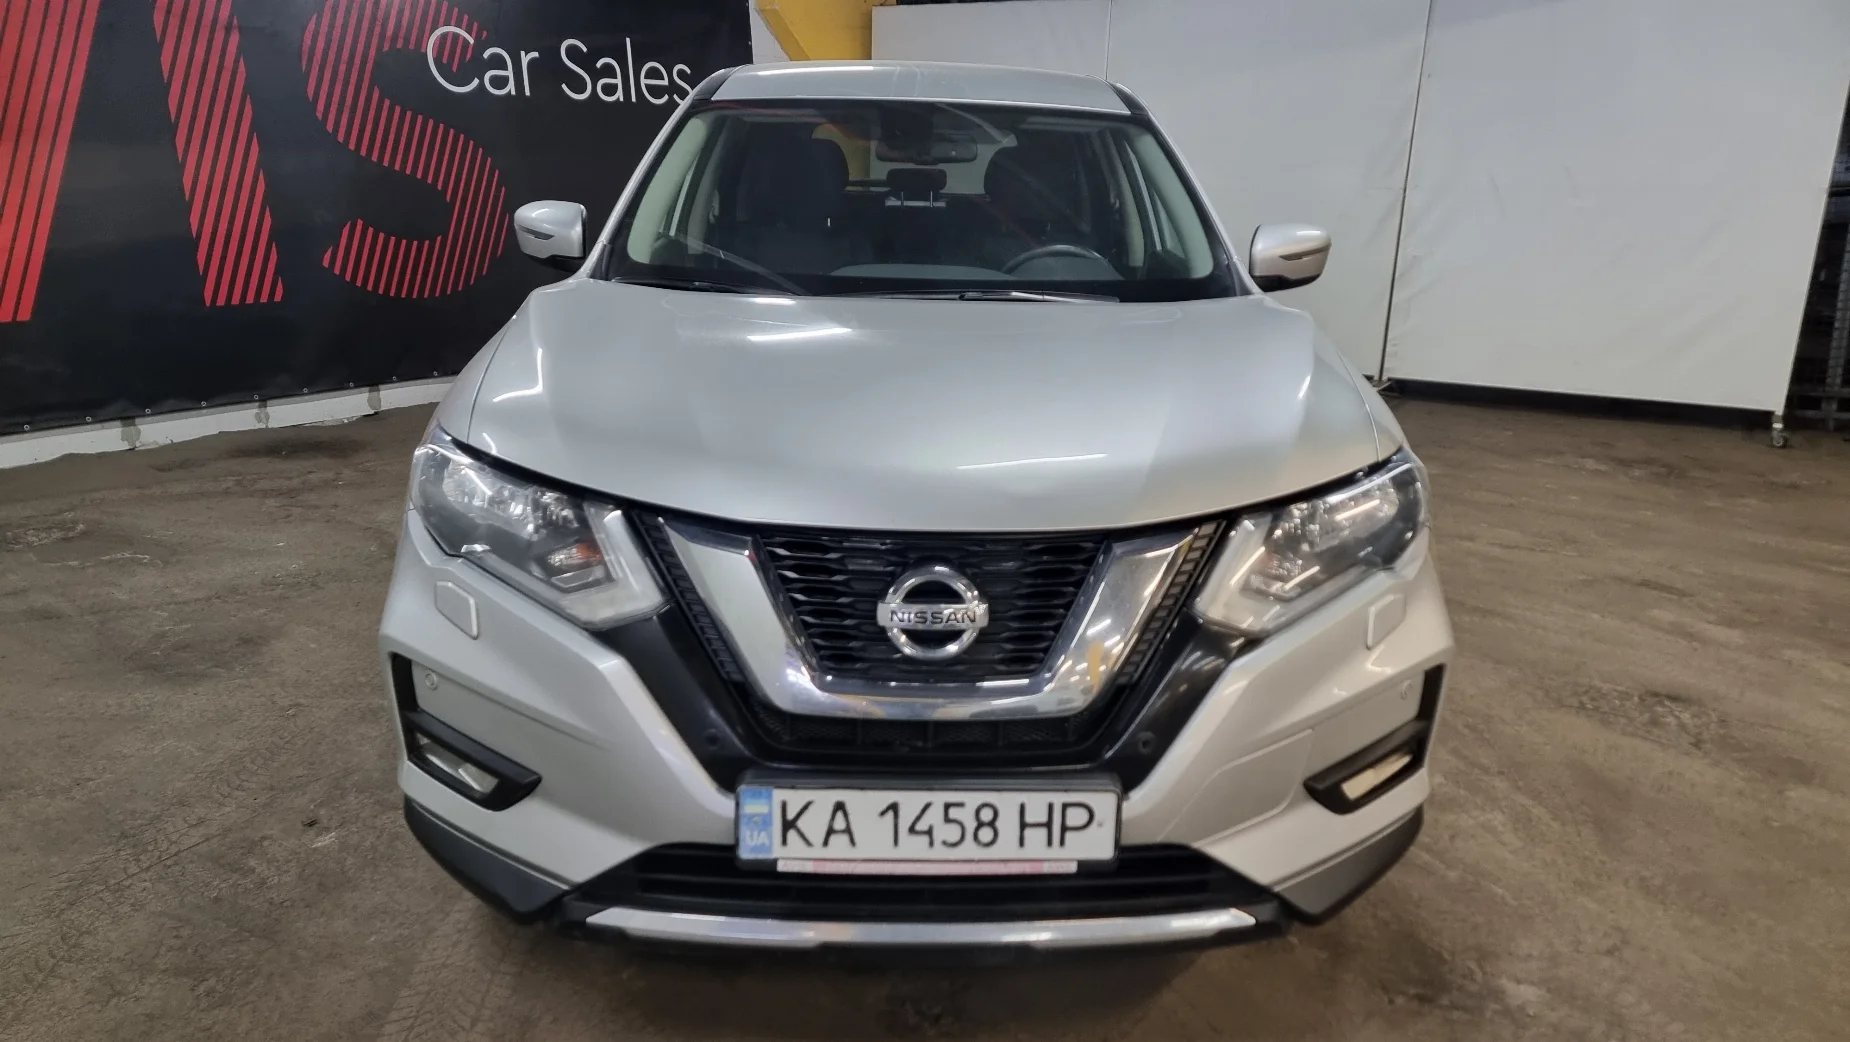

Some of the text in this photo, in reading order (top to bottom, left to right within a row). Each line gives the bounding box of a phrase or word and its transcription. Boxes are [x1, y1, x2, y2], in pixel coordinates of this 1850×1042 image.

[427, 25, 692, 104] Car Sales
[890, 610, 976, 624] NISSAN
[745, 830, 770, 846] UA
[781, 800, 1095, 848] KA 1458 HP
